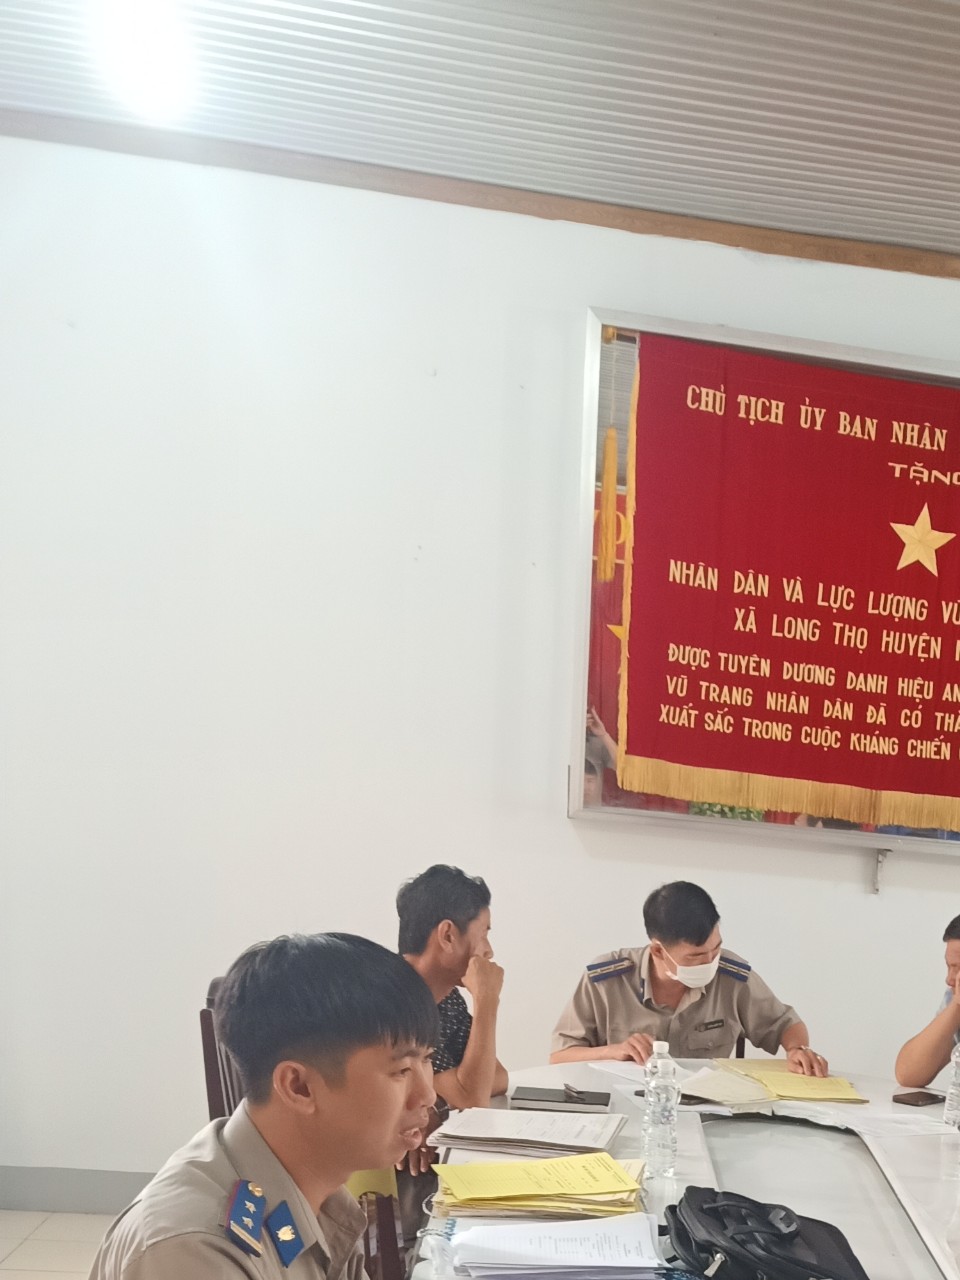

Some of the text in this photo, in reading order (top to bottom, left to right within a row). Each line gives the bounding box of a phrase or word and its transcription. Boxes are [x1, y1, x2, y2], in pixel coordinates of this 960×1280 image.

[687, 384, 726, 415] CHỦ
[737, 395, 785, 425] TỊCH
[800, 397, 826, 430] ỦY
[838, 411, 878, 441] BAN
[890, 421, 947, 451] NHÂN
[669, 559, 718, 591] NHÂN
[733, 569, 769, 597] DÂN
[783, 576, 803, 603] VÀ
[817, 582, 855, 613] LỰC
[868, 591, 928, 622] LƯỢNG
[734, 606, 757, 633] XÃ
[772, 614, 821, 641] LONG
[833, 622, 868, 654] THỌ
[881, 630, 941, 662] HUYỆN
[666, 675, 688, 697] VŨ
[699, 681, 753, 707] TRANG
[766, 691, 809, 714] NHÂN
[823, 698, 853, 721] DÂN
[866, 703, 886, 725] ĐÃ
[900, 705, 922, 728] CÓ
[668, 643, 710, 670] ĐƯỢC
[718, 652, 770, 678] TUYÊN
[783, 661, 835, 686] DƯƠNG
[846, 671, 888, 694] DANH
[898, 677, 933, 702] HIỆU
[659, 703, 699, 728] XUẤT
[704, 708, 734, 733] SẮC
[742, 717, 792, 742] TRONG
[801, 726, 841, 751] CUỘC
[850, 731, 899, 755] KHÁNG
[907, 735, 951, 760] CHIẾN
